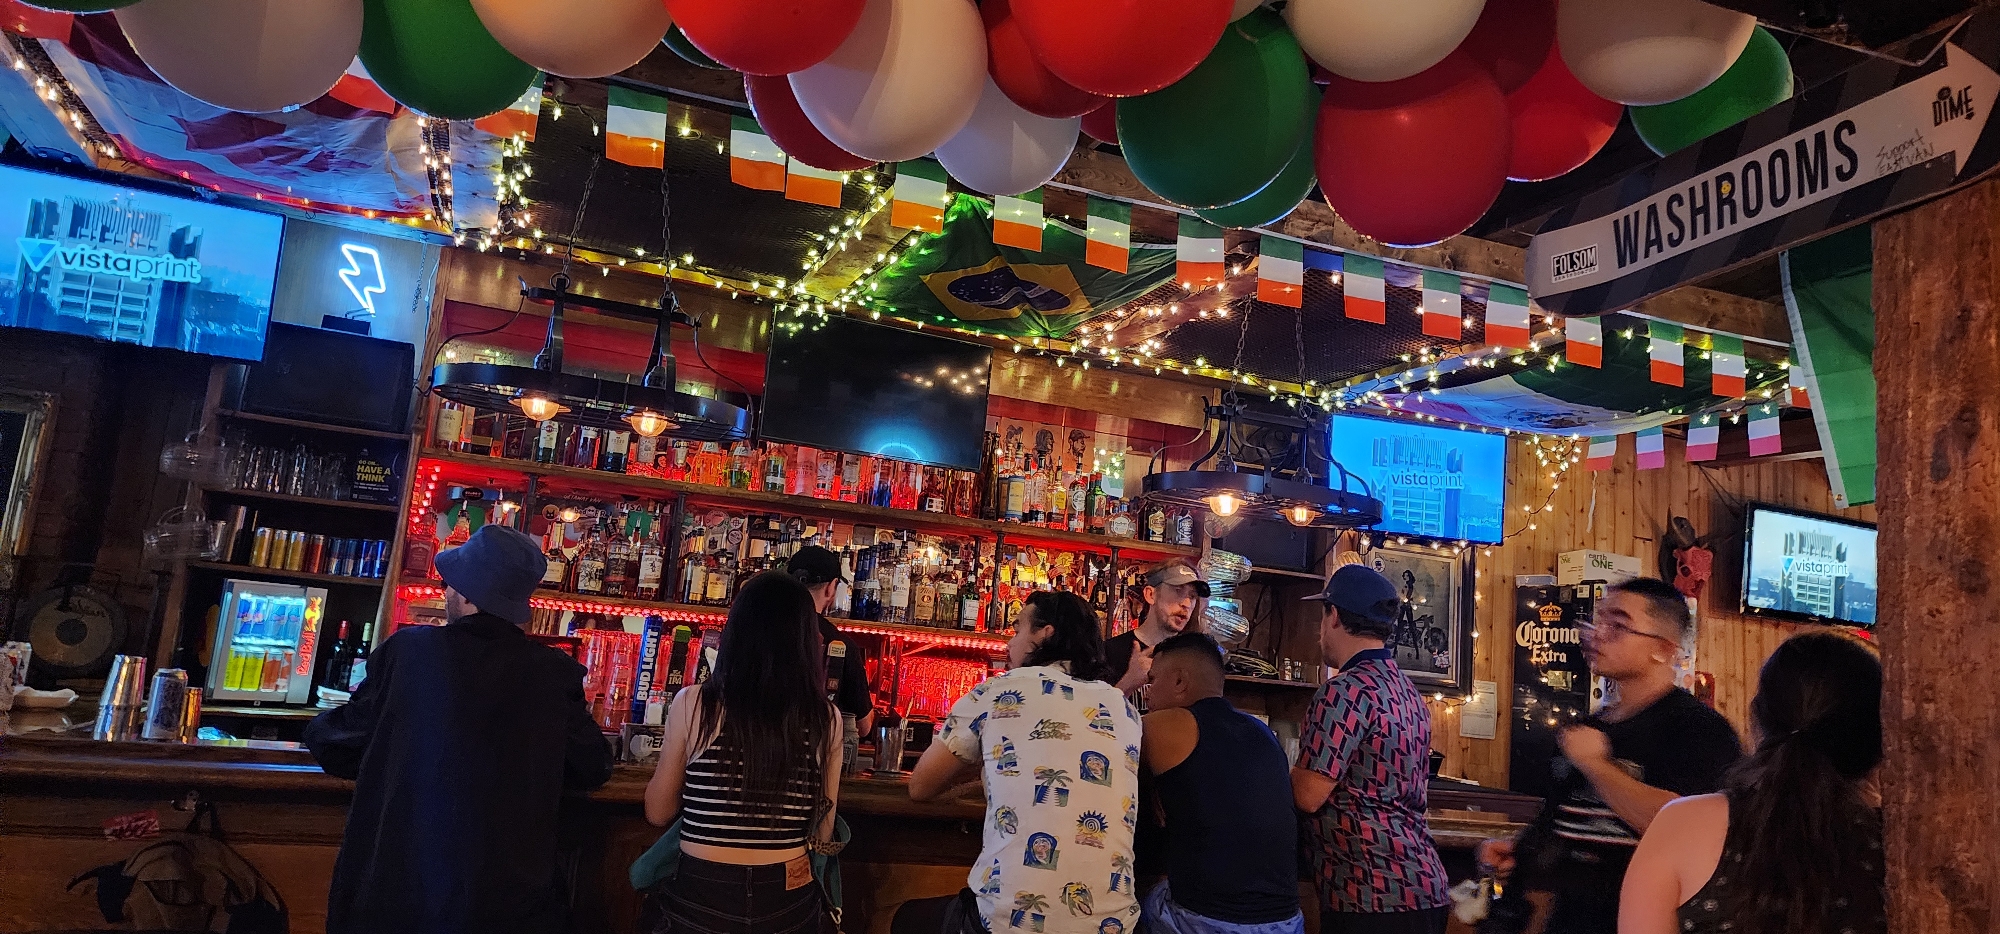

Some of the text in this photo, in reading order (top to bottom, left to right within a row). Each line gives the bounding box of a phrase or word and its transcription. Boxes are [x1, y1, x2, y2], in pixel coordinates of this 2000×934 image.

[1932, 85, 1974, 127] DIME
[1613, 119, 1859, 269] WASHROOMS
[61, 247, 198, 279] vistaprint
[1553, 247, 1597, 276] FOLSOM
[356, 465, 391, 475] HAVE A
[356, 472, 385, 483] THINK
[1392, 470, 1463, 489] vistaprint
[1591, 559, 1614, 570] ONE
[1795, 558, 1848, 576] vistaprint
[1515, 620, 1580, 650] Corona
[296, 631, 316, 676] Red Bull
[636, 628, 659, 701] BUD LIGHT
[1530, 644, 1567, 664] Extra
